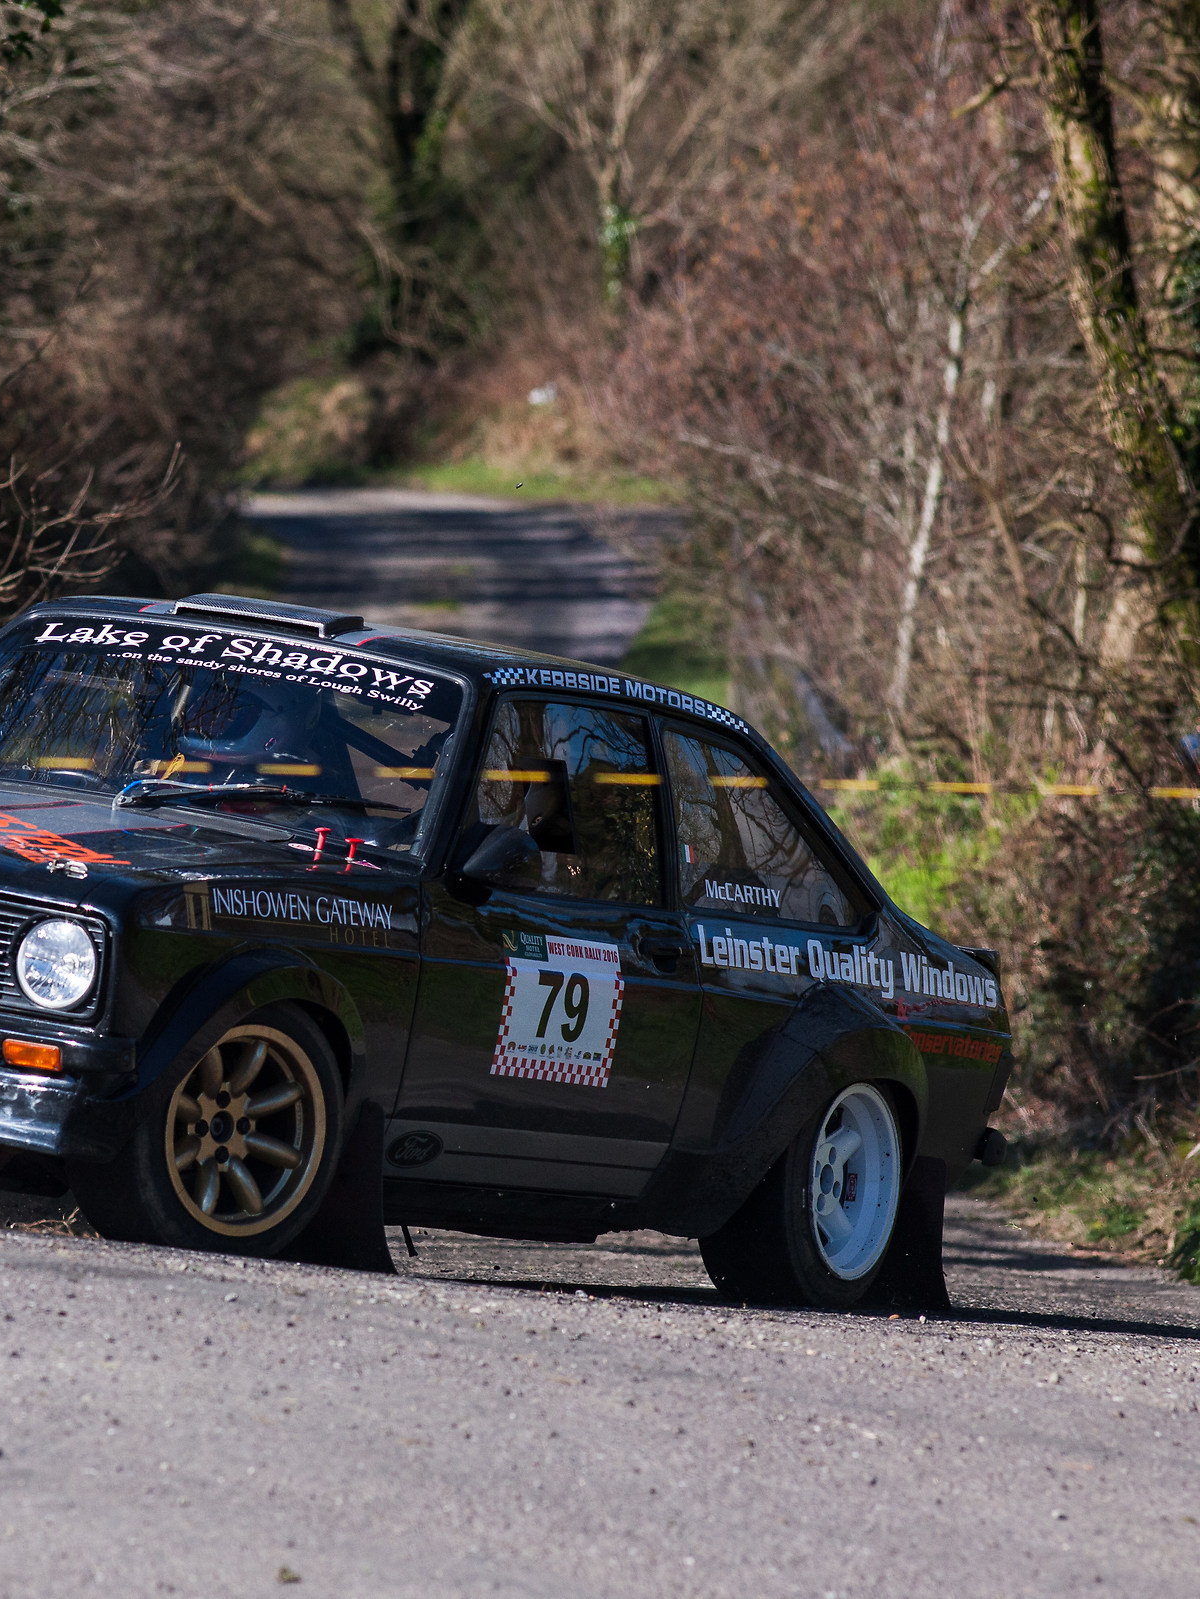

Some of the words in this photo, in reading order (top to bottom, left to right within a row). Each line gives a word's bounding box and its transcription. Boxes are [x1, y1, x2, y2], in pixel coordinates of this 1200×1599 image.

[35, 622, 149, 647] Lake
[162, 634, 223, 654] of
[221, 637, 435, 699] Shadows
[147, 653, 172, 664] the
[175, 658, 225, 671] sandy
[228, 664, 282, 681] shores
[285, 673, 309, 684] of
[310, 677, 363, 696] Lough
[367, 689, 424, 712] Swilly
[525, 668, 621, 695] KERBSIDE
[625, 679, 706, 717] MOTORS
[212, 887, 311, 921] INISHOWEN
[316, 896, 393, 930] GATEWAY
[705, 879, 781, 908] McCARTHY
[329, 927, 391, 948] HOTEL
[547, 941, 565, 956] WEST
[566, 944, 584, 958] CORK
[584, 946, 603, 961] RALLY
[602, 950, 619, 964] 2016
[697, 924, 800, 976] Leinster
[806, 939, 895, 1000] Quality
[900, 951, 998, 1009] Windows
[535, 968, 590, 1043] 79
[394, 1135, 435, 1161] Ford
